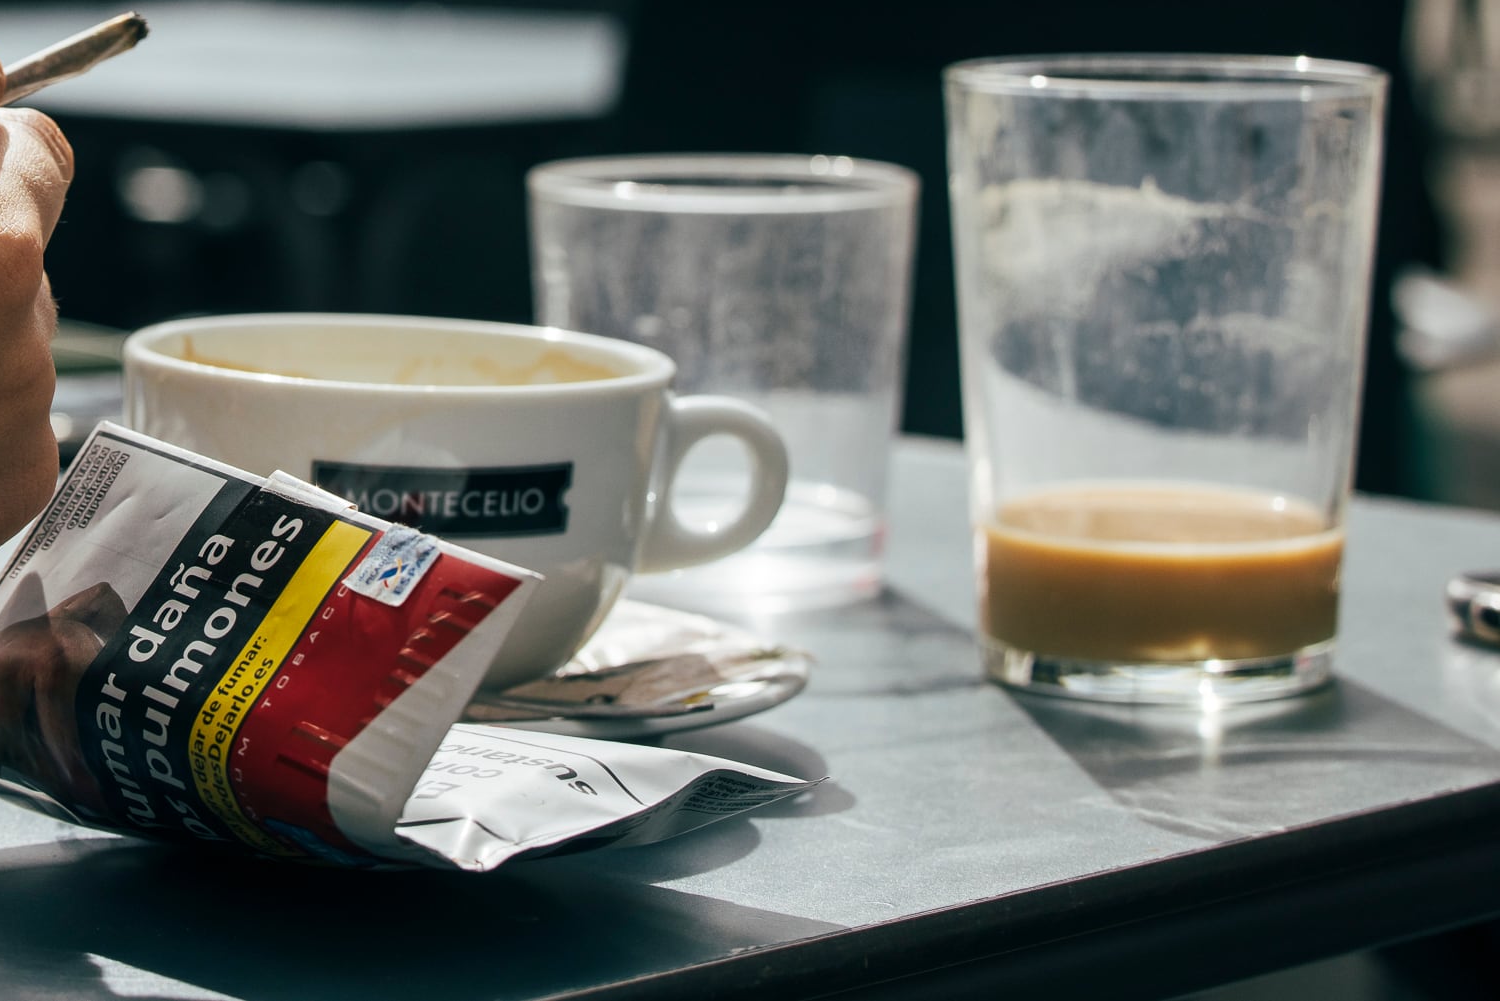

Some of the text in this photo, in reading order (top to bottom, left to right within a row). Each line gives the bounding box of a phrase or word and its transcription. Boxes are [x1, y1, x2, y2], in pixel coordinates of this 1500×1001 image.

[76, 444, 101, 479] TRAS
[78, 508, 95, 529] DE
[345, 487, 545, 518] MONTECELIO
[41, 521, 65, 550] UNA
[129, 534, 235, 663] daña
[142, 513, 303, 791] pulmones
[261, 584, 349, 710] TOBACC
[193, 729, 206, 784] dejar
[202, 700, 221, 726] de
[217, 635, 269, 697] fumar:
[428, 761, 503, 779] con
[438, 744, 598, 797] sustanc
